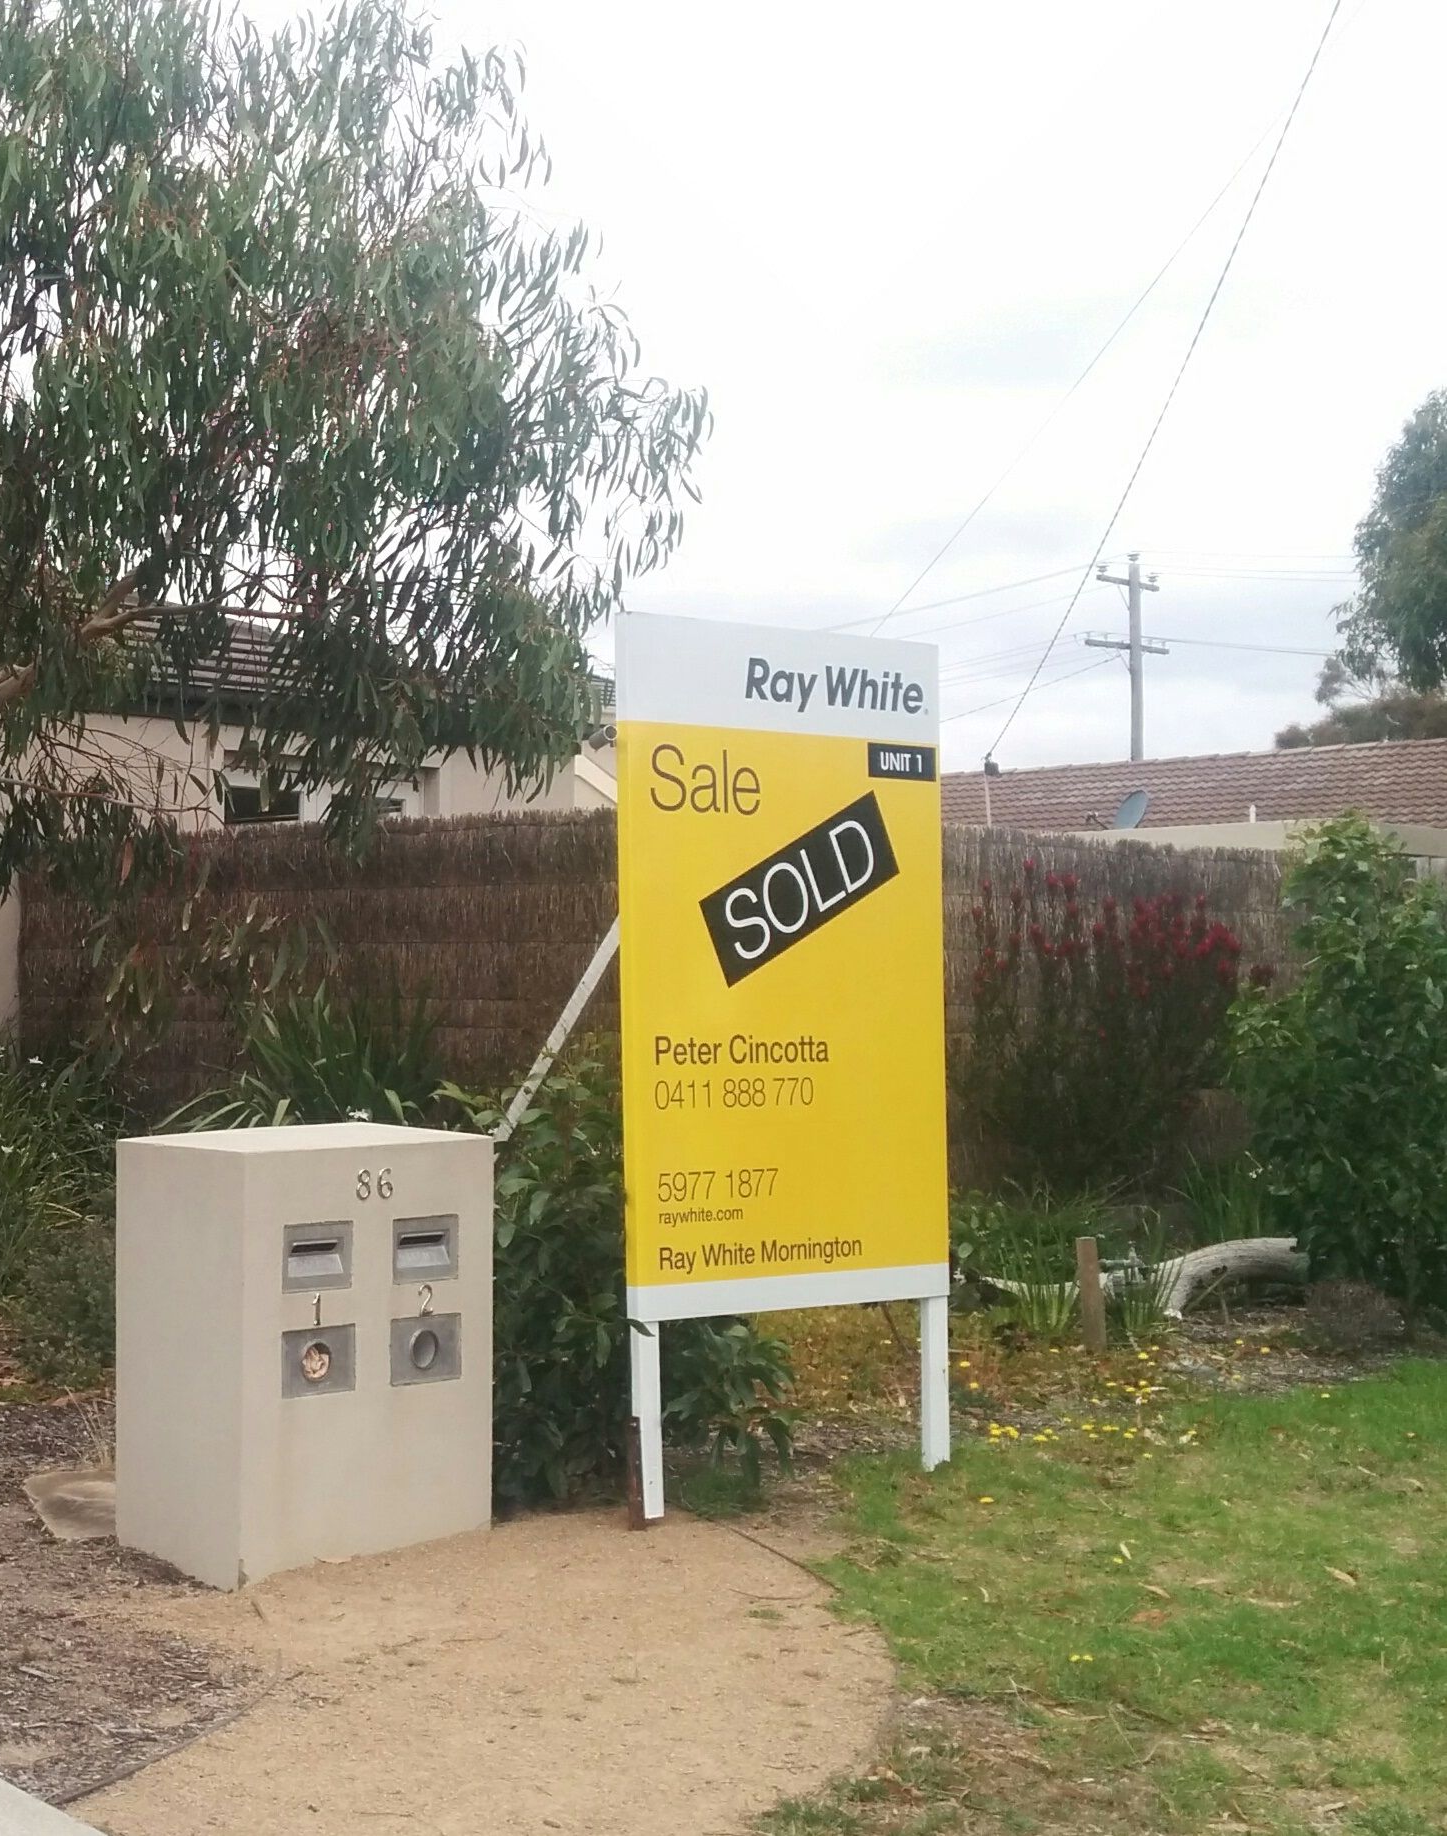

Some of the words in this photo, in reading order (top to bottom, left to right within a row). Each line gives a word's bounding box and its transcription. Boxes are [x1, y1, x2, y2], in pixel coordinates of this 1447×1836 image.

[745, 657, 817, 712] Ray
[880, 752, 911, 771] UNIT
[916, 755, 922, 772] 1
[651, 744, 761, 816] Sale
[725, 820, 874, 959] SOLD
[655, 1036, 722, 1066] Peter
[729, 1035, 829, 1063] Cincotta
[655, 1079, 711, 1110] 0411
[723, 1078, 765, 1107] 888
[773, 1077, 813, 1106] 770
[356, 1167, 394, 1200] 86
[658, 1171, 715, 1202] 5977
[725, 1168, 779, 1198] 1877
[658, 1208, 743, 1227] raywhite.com
[659, 1247, 695, 1275] Ray
[702, 1243, 755, 1267] White
[761, 1238, 862, 1265] Mornington
[312, 1293, 321, 1325] 1
[417, 1284, 434, 1316] 2
